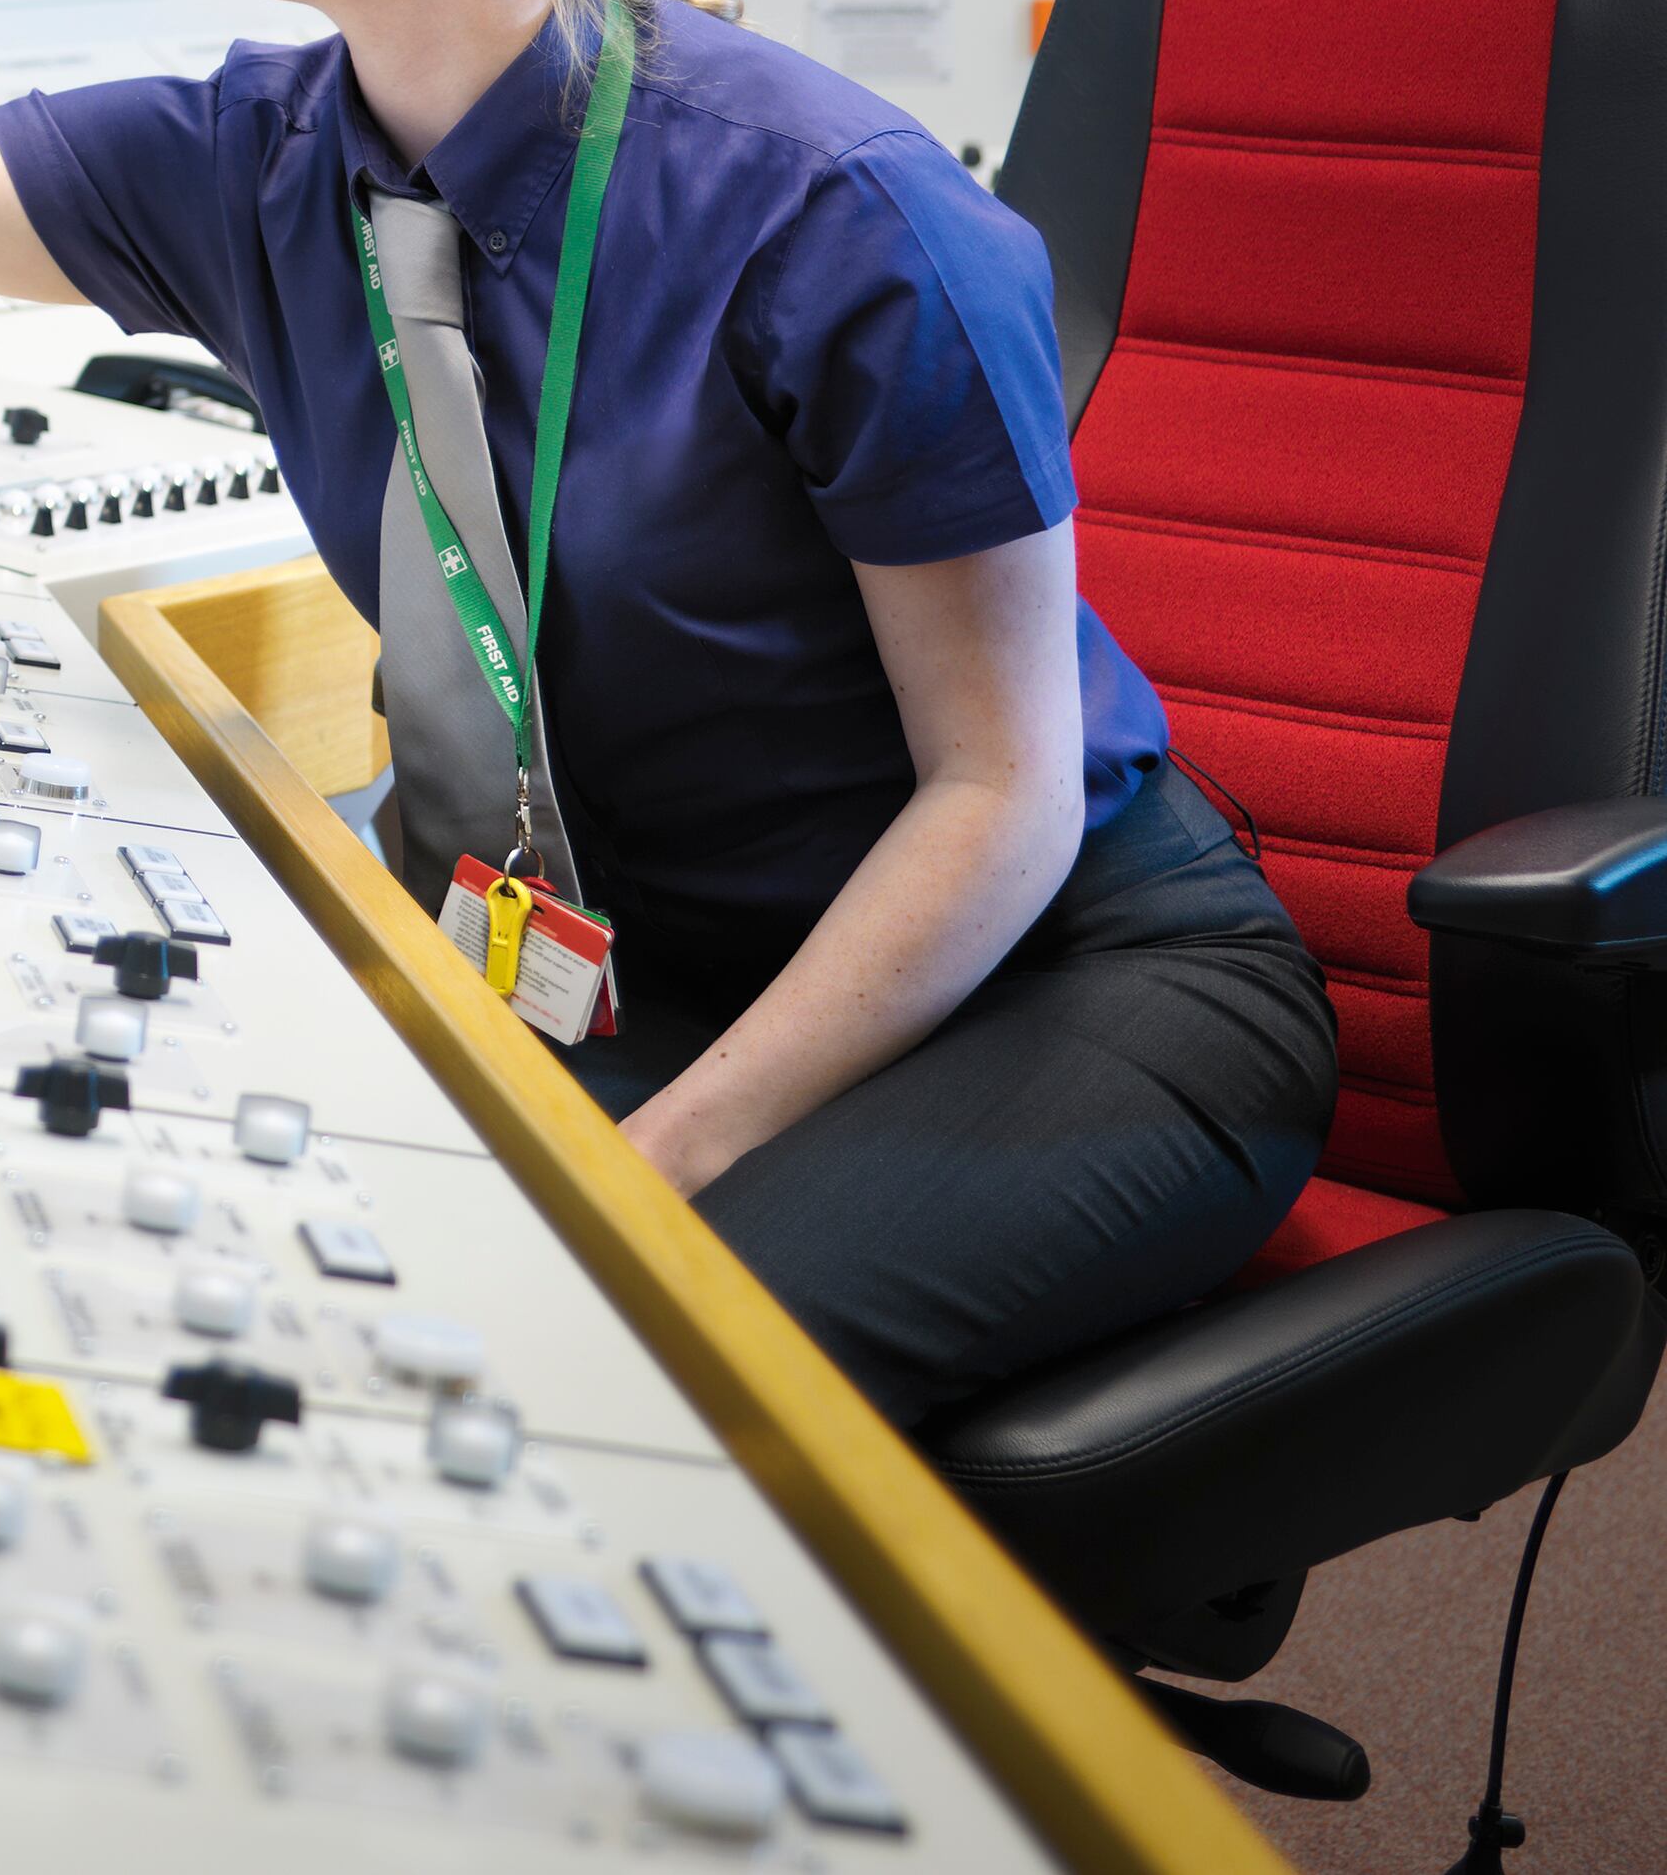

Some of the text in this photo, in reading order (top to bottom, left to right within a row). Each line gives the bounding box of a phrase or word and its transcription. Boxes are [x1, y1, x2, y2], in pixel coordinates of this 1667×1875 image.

[368, 263, 381, 291] AID
[401, 420, 427, 498] FIRST AID
[476, 624, 520, 703] FIRST AID
